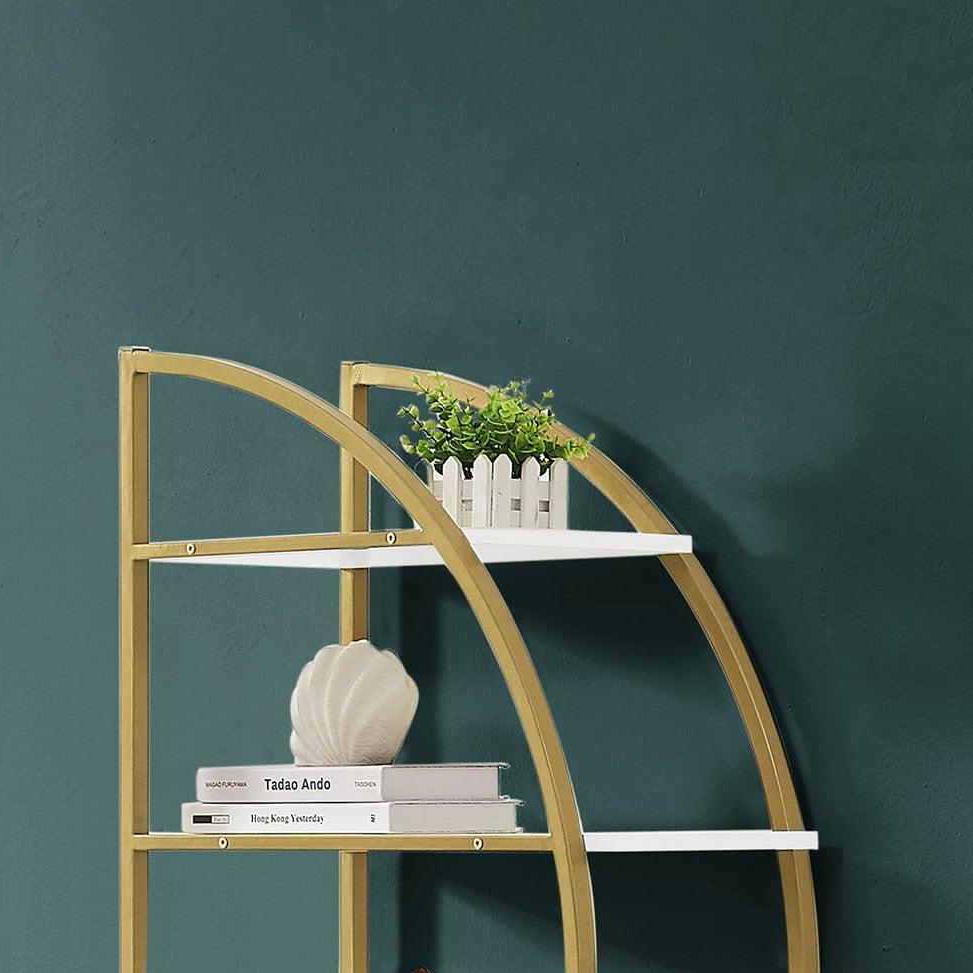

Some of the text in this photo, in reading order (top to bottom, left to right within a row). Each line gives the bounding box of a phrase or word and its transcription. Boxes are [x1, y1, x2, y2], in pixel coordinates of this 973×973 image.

[264, 777, 331, 791] Tadao Ando
[250, 814, 325, 825] Hong Kong Yesterday
